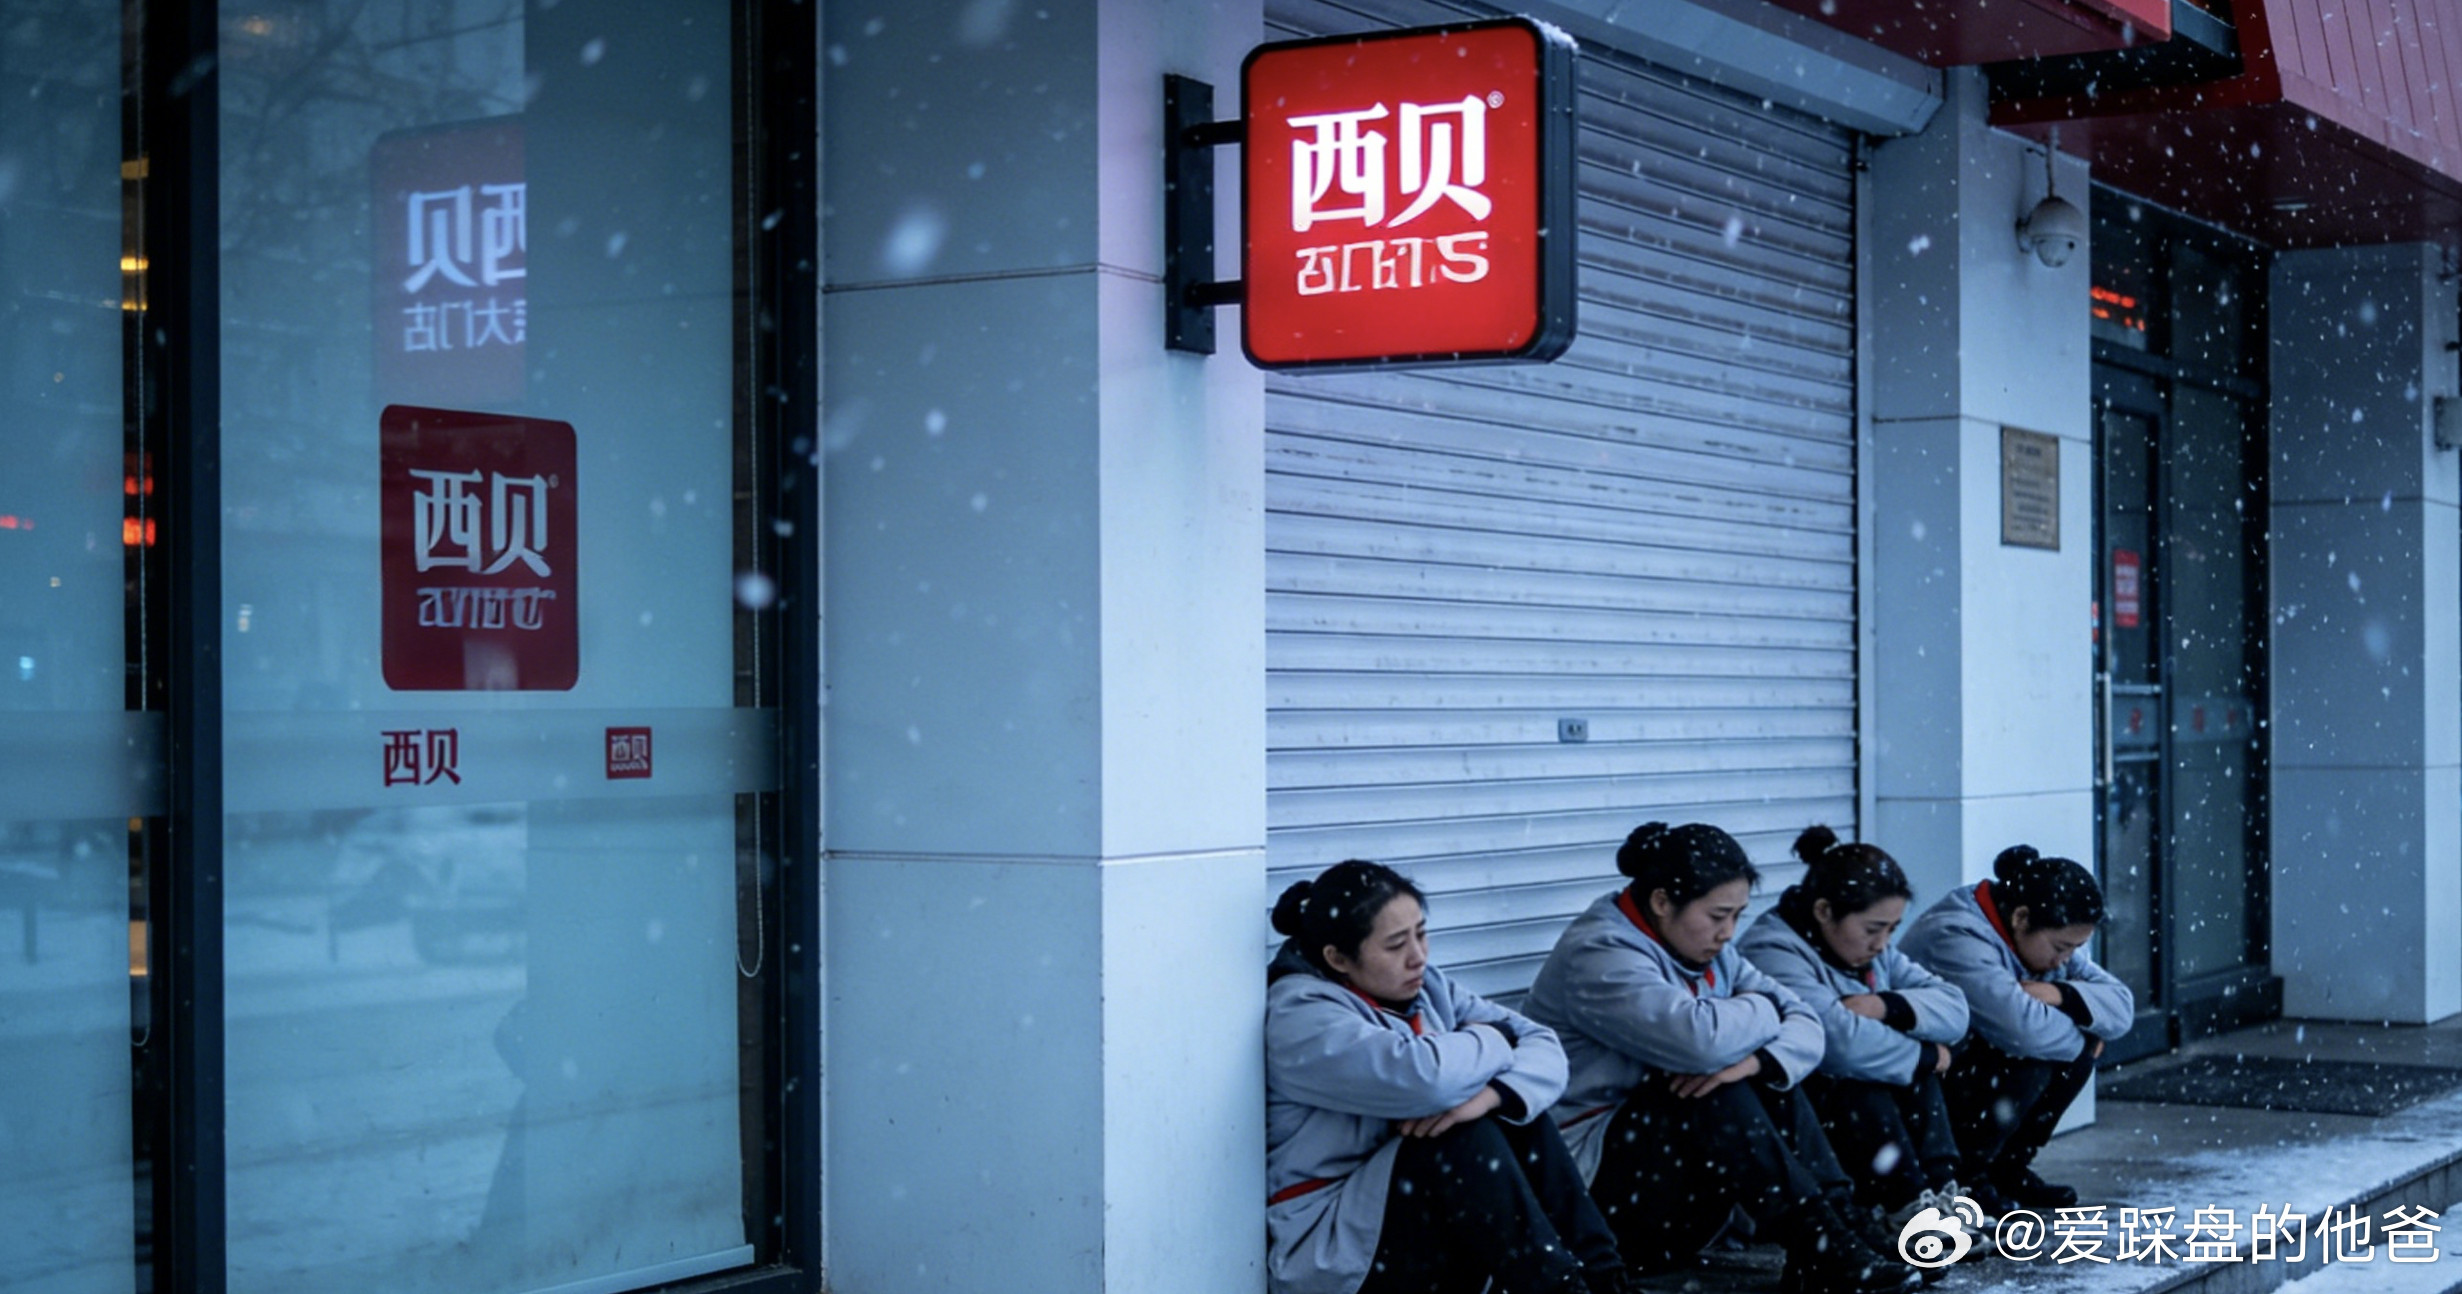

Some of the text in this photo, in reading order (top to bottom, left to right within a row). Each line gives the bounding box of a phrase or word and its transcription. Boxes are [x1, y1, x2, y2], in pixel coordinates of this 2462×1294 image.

[1287, 94, 1492, 232] 西贝
[408, 468, 552, 578] 西贝
[380, 727, 462, 787] 西贝
